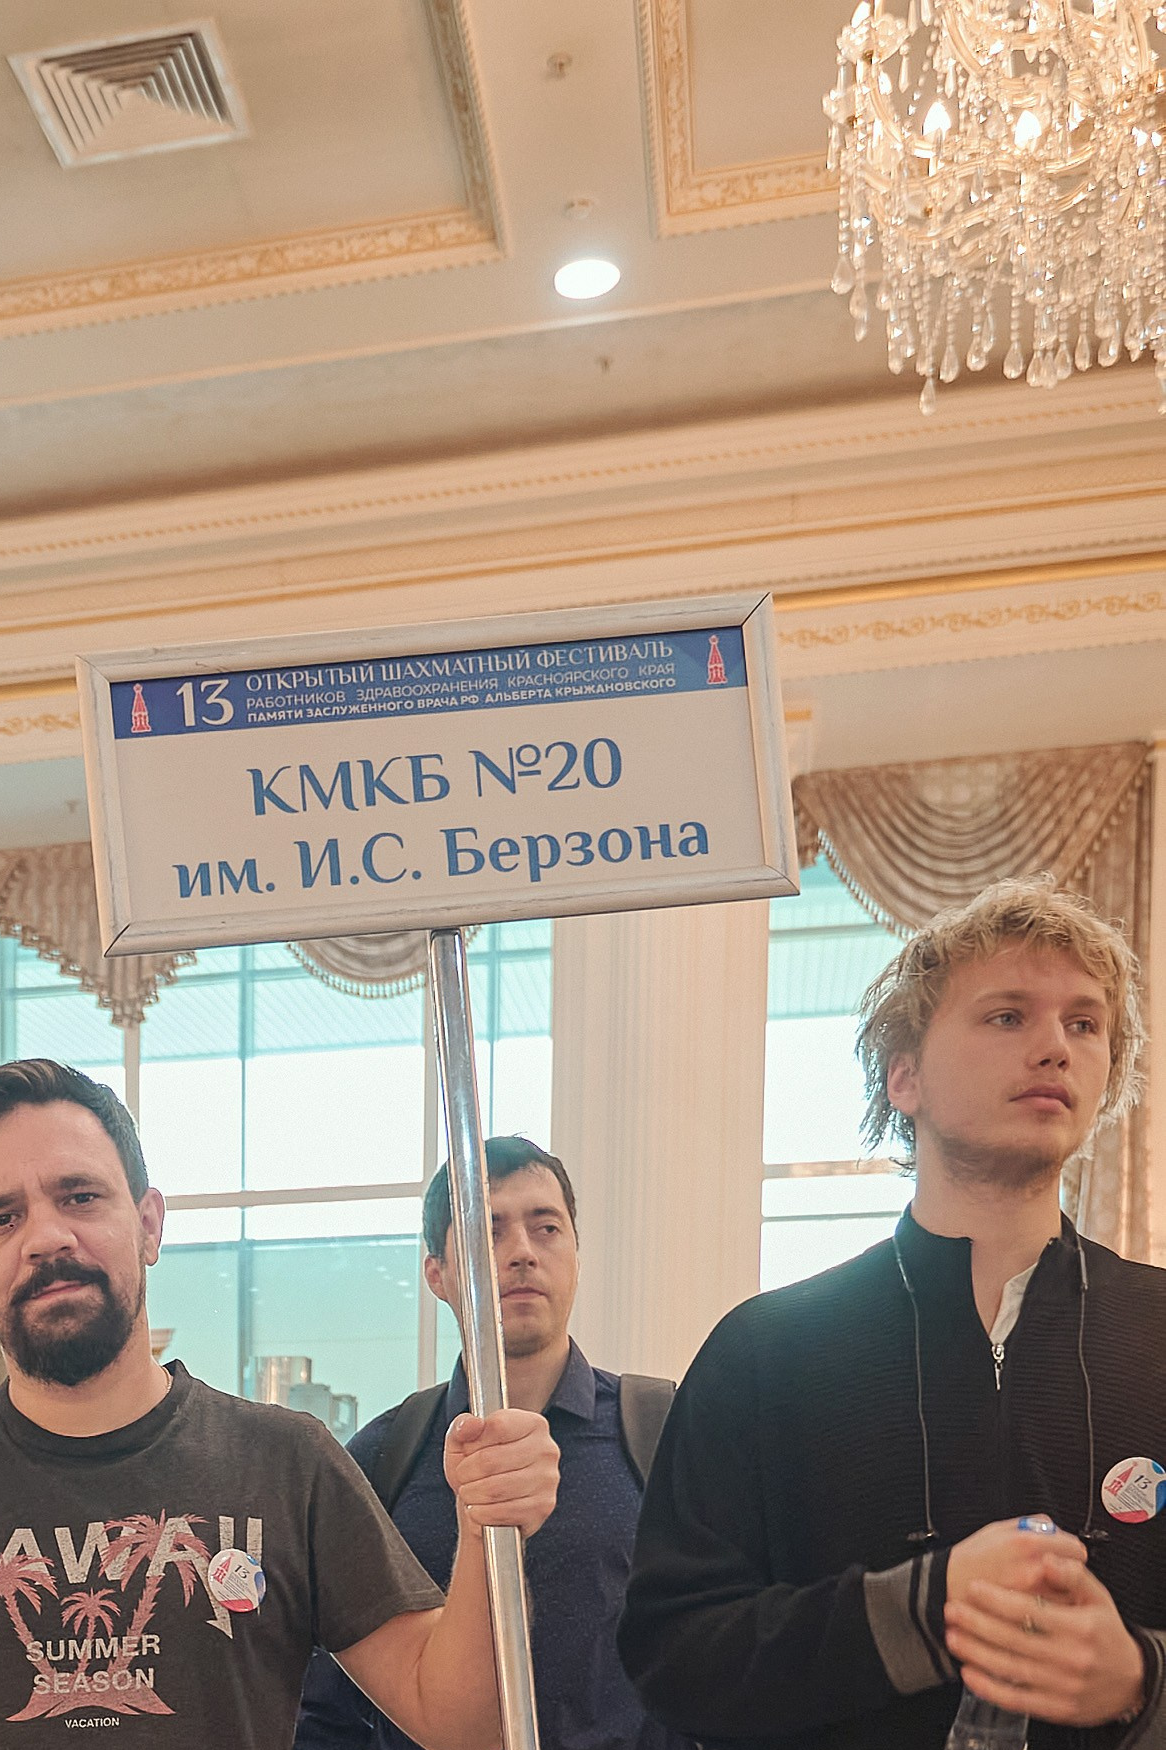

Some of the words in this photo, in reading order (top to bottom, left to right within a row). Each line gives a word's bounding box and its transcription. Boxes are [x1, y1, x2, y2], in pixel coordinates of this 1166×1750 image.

[245, 662, 375, 692] ОТКРЫТЫЙ
[380, 650, 531, 682] ШАХМАТНЫЙ
[536, 640, 674, 669] ФЕСТИВАЛЬ
[245, 691, 346, 710] РАБОТНИКОВ
[356, 677, 499, 701] ЗДРАВООХРАНЕНИЯ
[507, 667, 629, 689] КРАСНОЯРСКОГО
[638, 663, 675, 677] КРАЯ
[176, 679, 234, 727] 13
[247, 708, 304, 723] ПАМЯТИ
[306, 700, 414, 718] ЗАСЛУЖЕННОГО
[417, 696, 458, 709] ВРАЧА
[460, 694, 480, 705] РФ
[484, 687, 552, 704] АЛЬБЕРТА
[555, 678, 676, 697] КРЫЖАНОВСКОГО
[245, 753, 451, 816] КМКБ
[468, 737, 622, 797] №20
[172, 858, 276, 899] им.
[293, 832, 422, 888] И.С.
[439, 821, 710, 883] Берзона
[1134, 1474, 1152, 1490] 13
[234, 1564, 250, 1579] 13
[25, 1633, 161, 1664] SUMMER
[32, 1667, 155, 1695] SEASON
[64, 1716, 120, 1729] VACATION
